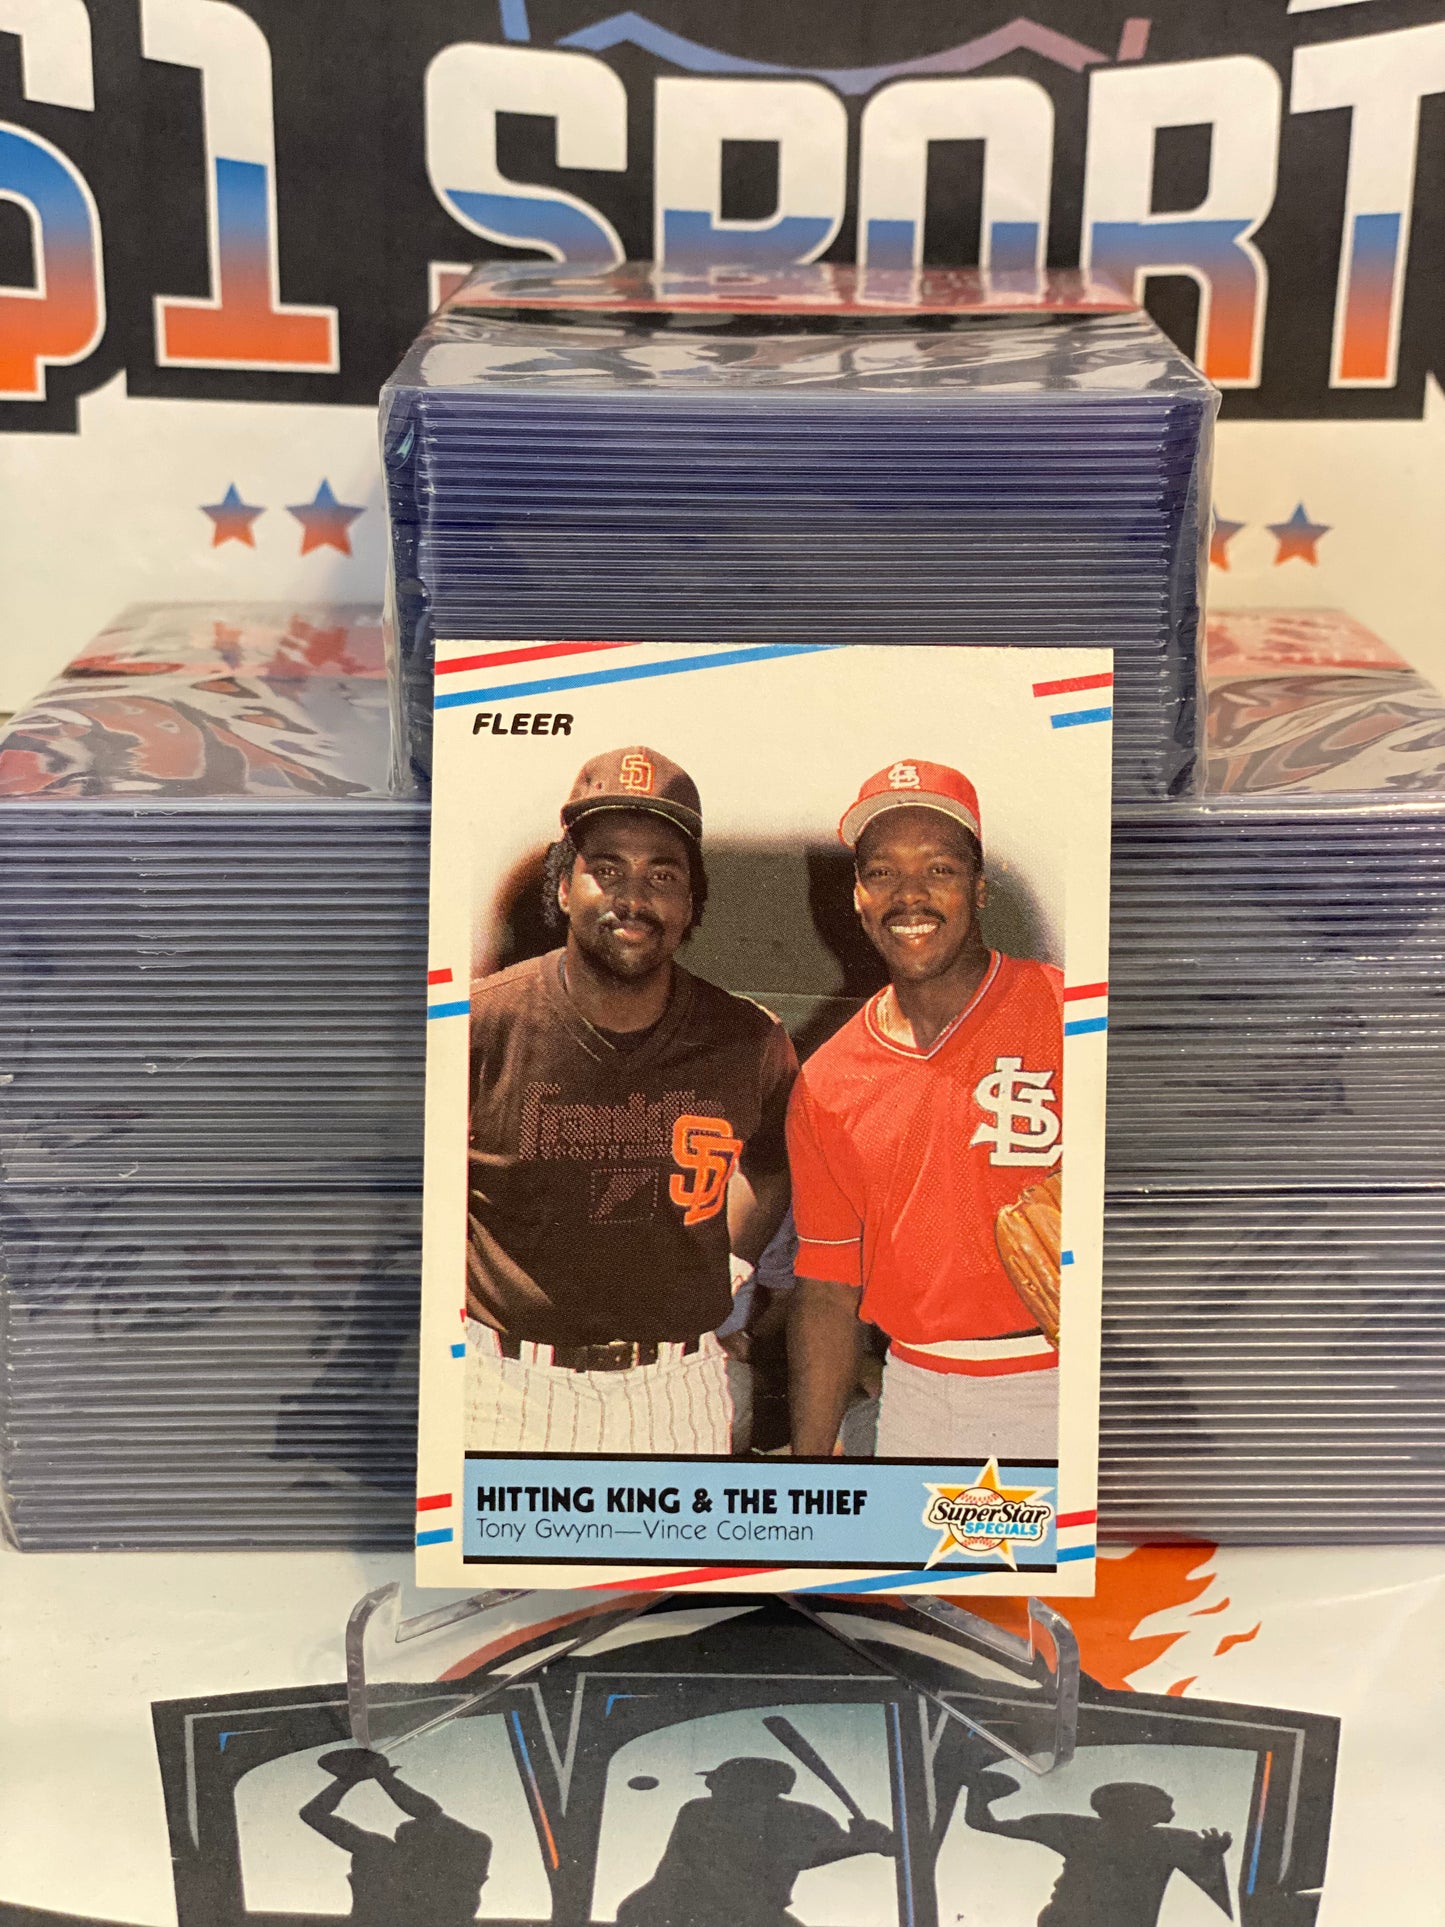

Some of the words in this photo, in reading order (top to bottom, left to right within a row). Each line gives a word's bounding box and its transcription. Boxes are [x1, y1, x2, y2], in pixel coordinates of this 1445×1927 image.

[472, 712, 574, 736] FLEER
[476, 1486, 595, 1513] HITTING
[607, 1487, 681, 1515] KING
[692, 1488, 713, 1515] &
[723, 1488, 778, 1515] THE
[788, 1489, 868, 1516] THIEF
[933, 1501, 1047, 1526] SuperStar
[476, 1518, 526, 1543] Tony
[717, 1519, 814, 1541] Coleman
[965, 1522, 1038, 1537] SPECIALS
